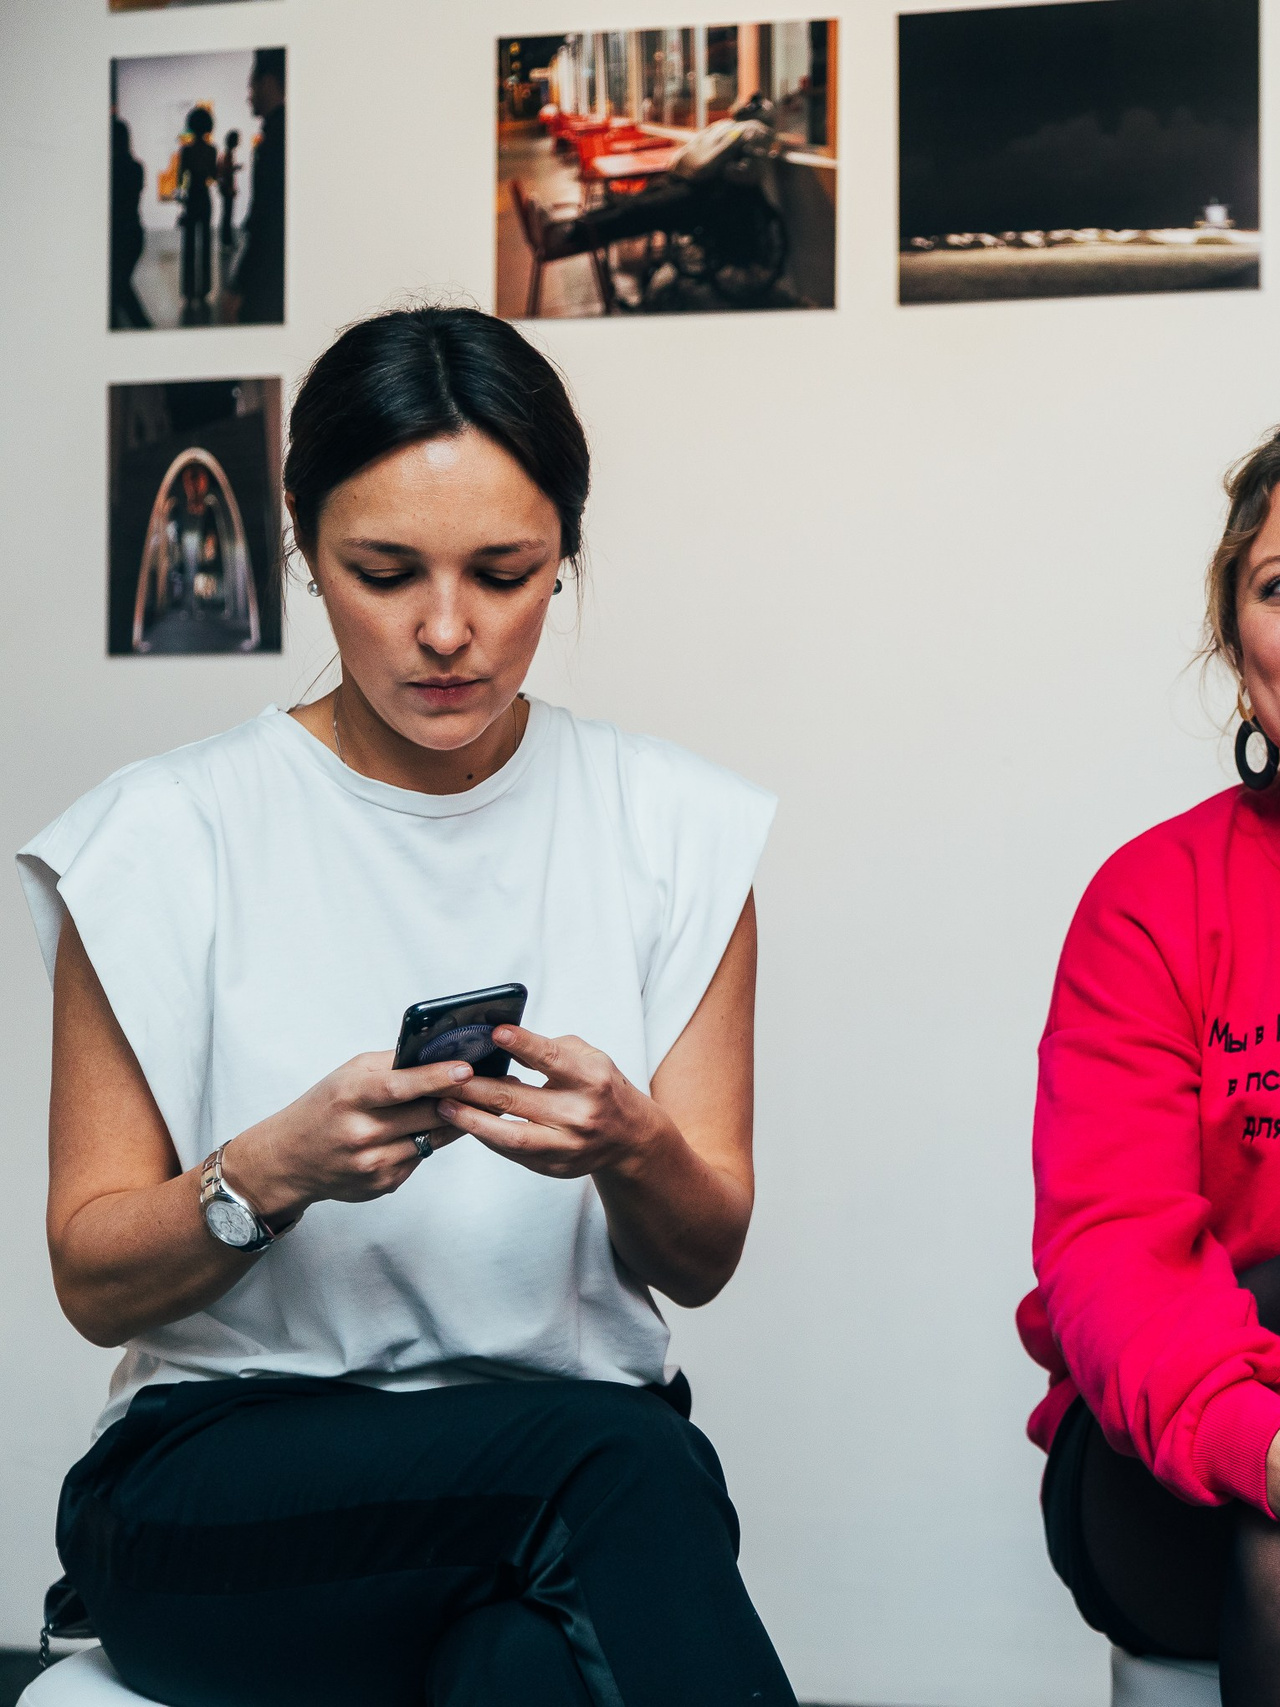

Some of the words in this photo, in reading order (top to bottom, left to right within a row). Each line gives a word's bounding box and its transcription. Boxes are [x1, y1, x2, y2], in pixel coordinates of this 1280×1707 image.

[1208, 1018, 1248, 1053] Мы
[1255, 1025, 1265, 1044] в
[1227, 1078, 1238, 1097] в
